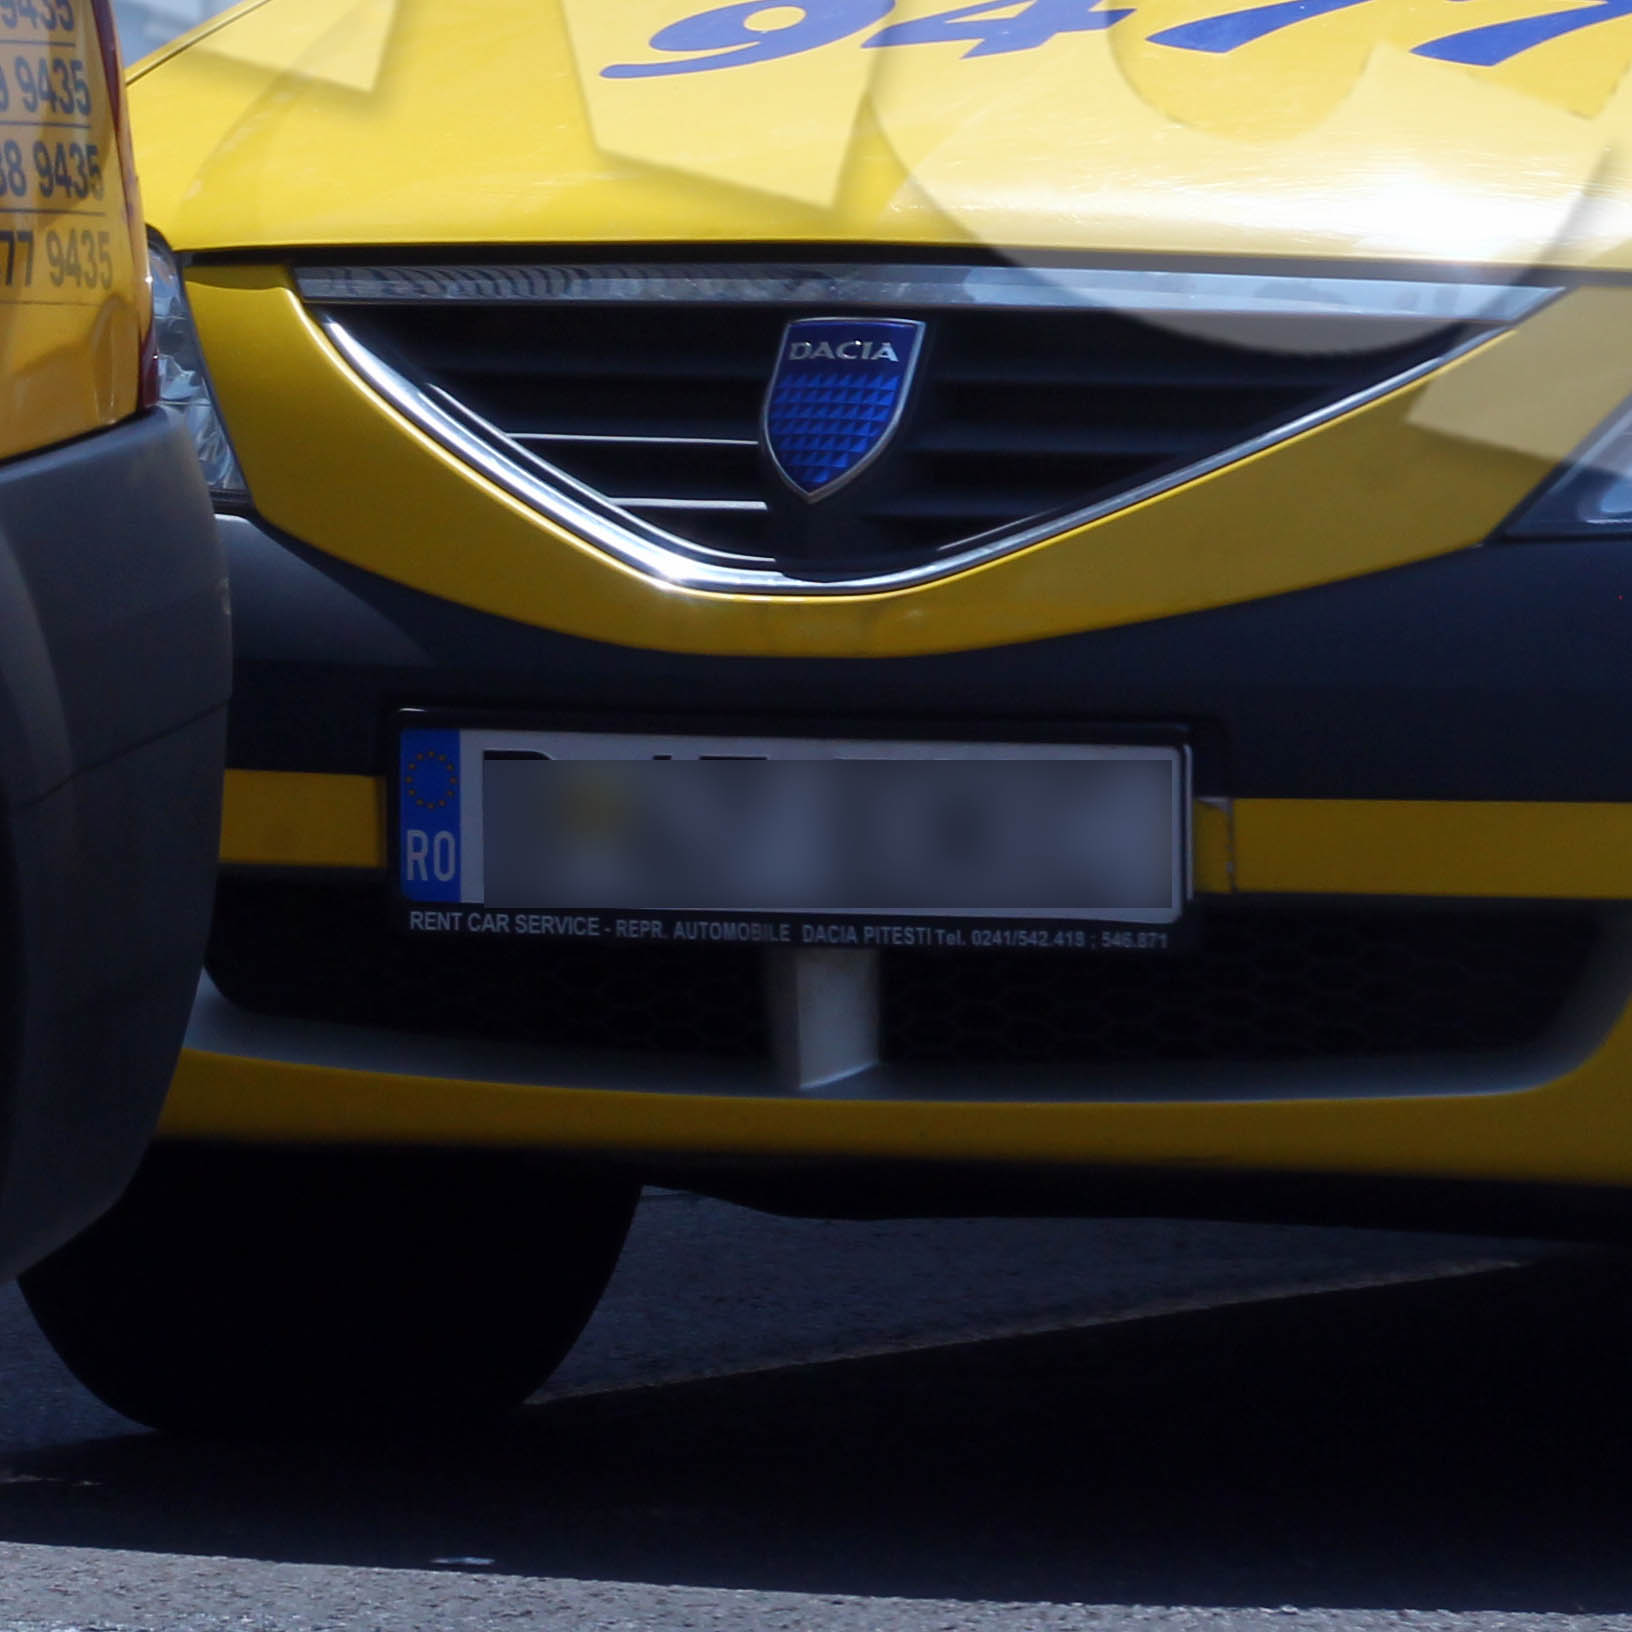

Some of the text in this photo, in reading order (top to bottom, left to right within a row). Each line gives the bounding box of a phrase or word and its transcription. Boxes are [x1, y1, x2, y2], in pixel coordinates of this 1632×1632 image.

[13, 55, 93, 117] 9435
[32, 139, 105, 201] 9435
[44, 228, 114, 291] 9435
[788, 339, 899, 363] DACIA
[404, 828, 457, 883] RO
[409, 910, 463, 932] RENT
[467, 912, 510, 934] CAR
[514, 914, 601, 937] SERVICE
[614, 919, 668, 939] REPR.
[672, 920, 791, 943] AUTOMOBILE
[801, 924, 858, 945] DACIA
[862, 925, 932, 946] PITESTI
[936, 928, 967, 947] Tel.
